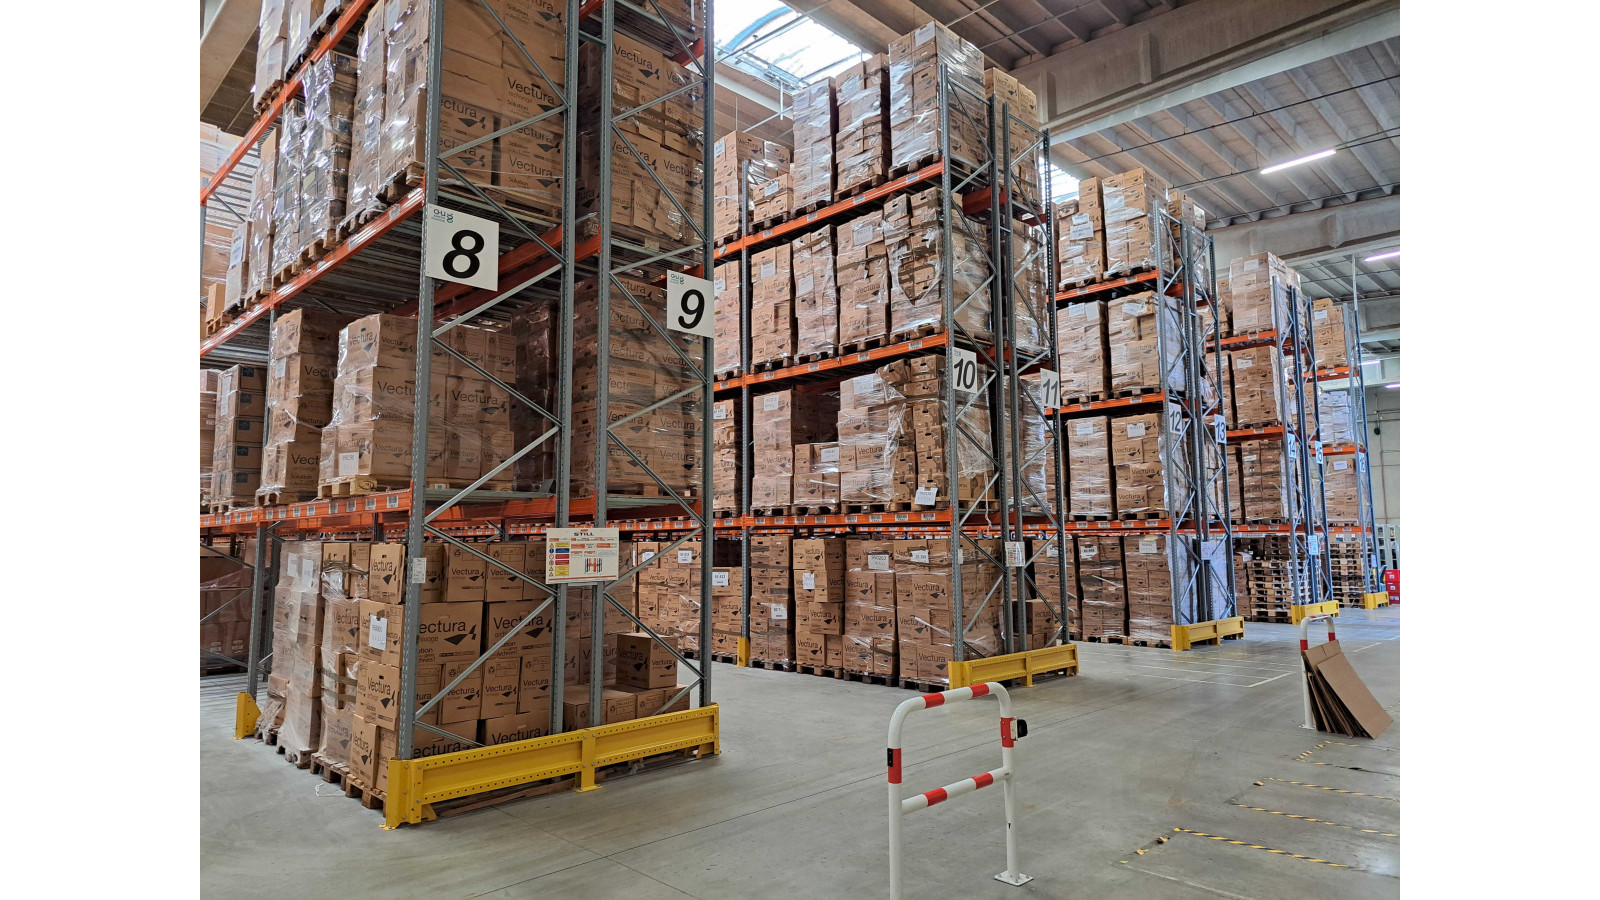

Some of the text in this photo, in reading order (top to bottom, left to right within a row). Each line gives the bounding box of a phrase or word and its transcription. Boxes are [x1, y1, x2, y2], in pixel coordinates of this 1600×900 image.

[613, 43, 653, 70] Vectura
[996, 76, 1013, 88] Vectura
[507, 76, 555, 106] Vectura
[439, 137, 476, 156] ectra
[612, 141, 650, 160] ectra
[509, 155, 553, 176] Vectura
[663, 159, 698, 180] Vectura
[442, 230, 484, 278] 8
[623, 280, 646, 294] ctura
[764, 282, 785, 290] Vectura
[855, 284, 880, 294] Vectura
[678, 289, 705, 329] 9
[840, 320, 860, 328] Vectura
[348, 331, 373, 346] Vectura
[381, 336, 408, 348] Vectura
[488, 353, 510, 362] Vectura
[954, 358, 976, 389] 10
[377, 380, 416, 396] Vectu
[1042, 378, 1058, 406] 11
[452, 390, 498, 404] Vectura
[660, 418, 694, 430] Vectura
[1170, 410, 1181, 432] 12
[1216, 421, 1226, 441] 13
[375, 444, 403, 452] Vectura
[857, 446, 883, 455] Vectura
[291, 454, 320, 466] Vect
[660, 450, 694, 462] Vectura
[371, 560, 392, 572] Vectura
[426, 568, 437, 576] tura
[847, 580, 869, 588] Vectura
[334, 612, 359, 624] Vectura
[810, 610, 832, 618] Vectura
[861, 613, 887, 622] Vectura
[420, 620, 466, 634] ectura
[798, 640, 819, 649] Vectura
[582, 648, 616, 660] Vtur
[618, 647, 642, 660] Vectura
[919, 653, 946, 663] Vectura
[368, 677, 391, 696] Vectura
[485, 684, 512, 693] Vectura
[523, 678, 549, 687] Vectura
[353, 731, 369, 752] Vectura
[492, 727, 541, 746] Vectura
[413, 742, 461, 758] ectura
